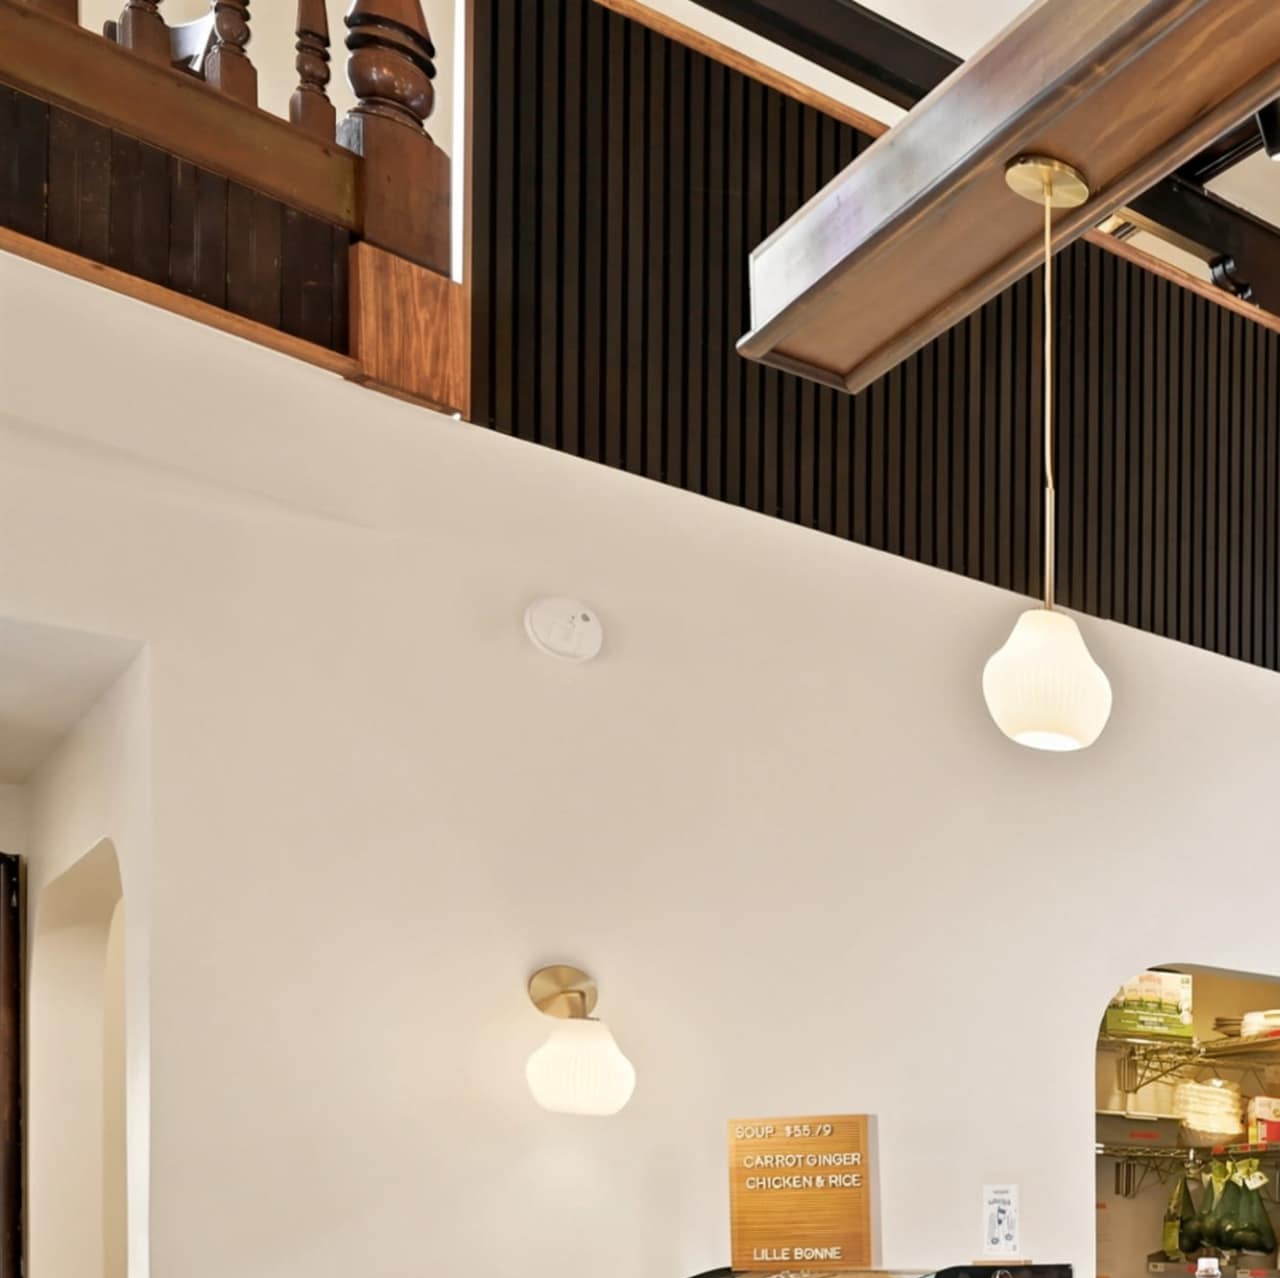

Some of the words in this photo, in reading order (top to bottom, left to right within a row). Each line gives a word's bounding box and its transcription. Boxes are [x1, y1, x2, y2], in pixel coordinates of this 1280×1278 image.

[736, 1126, 775, 1138] SOUP
[743, 1155, 804, 1169] CARROT
[806, 1153, 862, 1167] GINGER
[746, 1176, 813, 1190] CHICKEN
[815, 1176, 826, 1188] &
[828, 1174, 863, 1187] RICE
[753, 1248, 791, 1261] LILLE
[794, 1247, 843, 1260] BONNE
